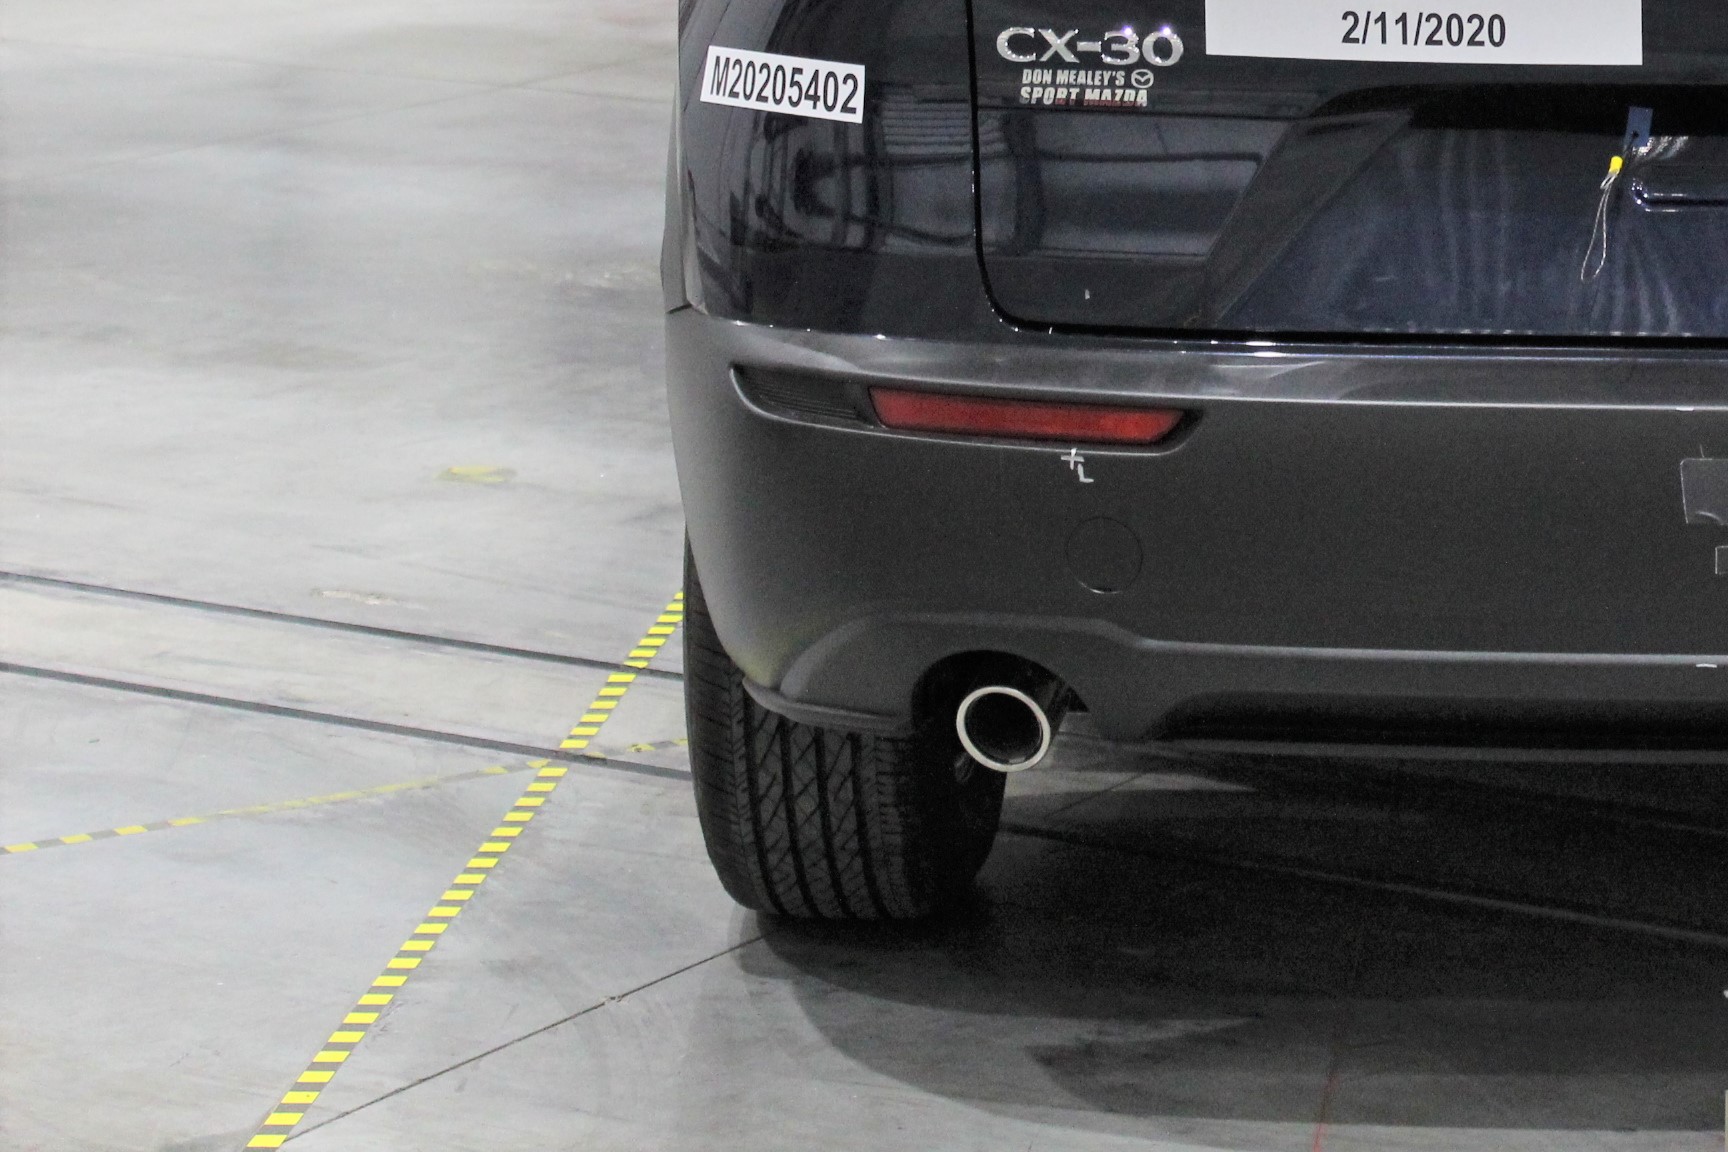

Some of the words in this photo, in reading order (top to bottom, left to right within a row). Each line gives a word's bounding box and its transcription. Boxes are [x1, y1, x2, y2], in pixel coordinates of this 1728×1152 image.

[996, 26, 1184, 67] CX-30
[1341, 10, 1507, 48] 2/11/2020
[710, 55, 859, 115] M20205402
[1022, 69, 1051, 85] DON
[1056, 69, 1125, 86] MEALEY'S
[1019, 87, 1080, 106] SPORT
[1083, 88, 1148, 107] MAZDA
